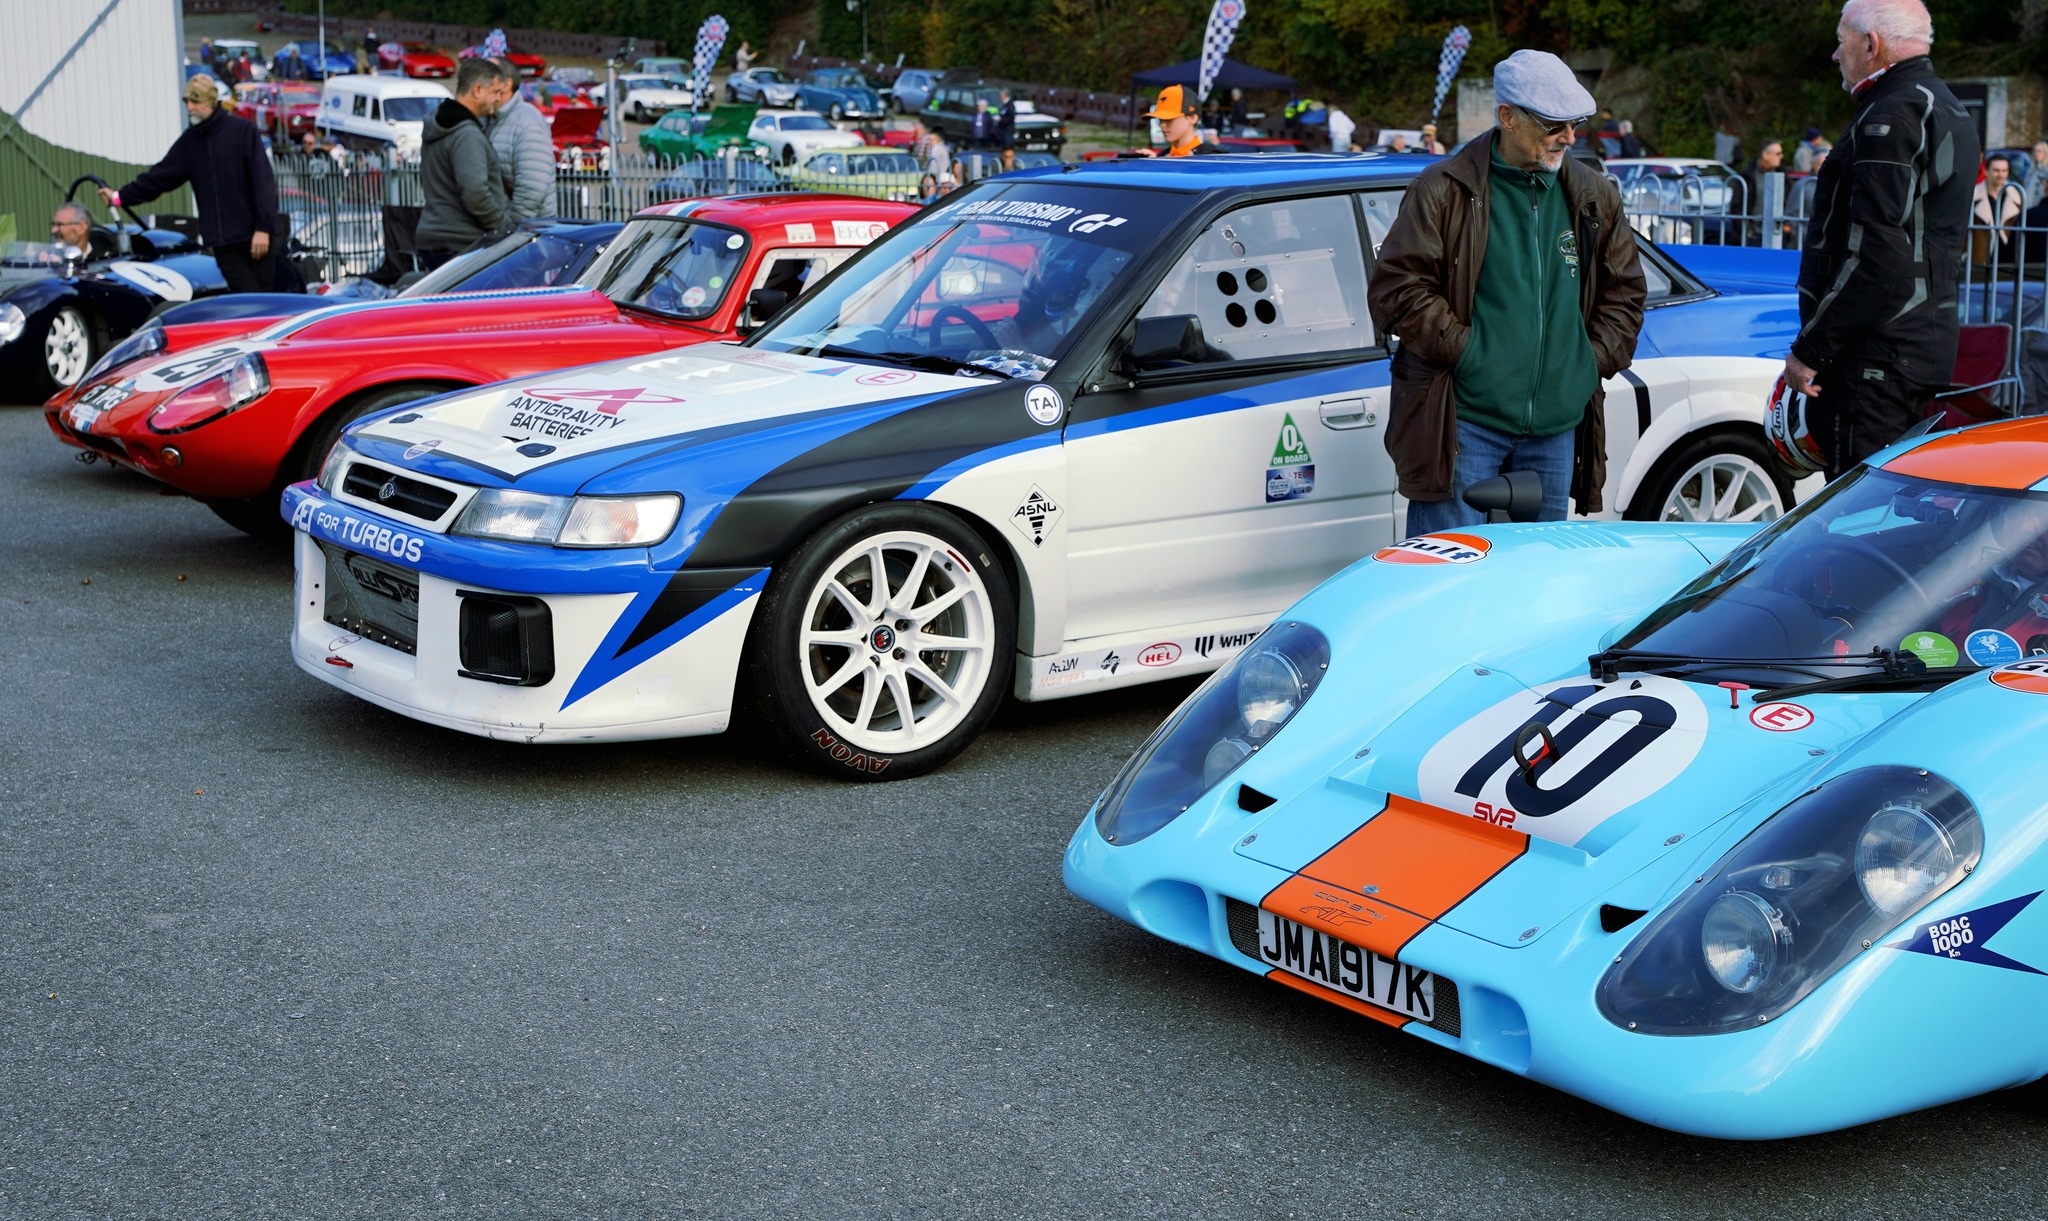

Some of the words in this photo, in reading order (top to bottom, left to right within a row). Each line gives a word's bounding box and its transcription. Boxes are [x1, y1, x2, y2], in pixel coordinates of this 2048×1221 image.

[956, 200, 1008, 215] GRAN
[837, 225, 868, 240] EFG
[1007, 216, 1052, 228] SIMULATOR
[867, 372, 906, 384] E
[507, 396, 627, 429] ANTIGRAVITY
[1030, 396, 1058, 411] TAI
[1273, 456, 1284, 465] ON
[1284, 454, 1309, 464] BOARD
[317, 512, 340, 532] FOR
[342, 515, 425, 563] TURBOS
[1389, 538, 1479, 561] Gulf
[1220, 631, 1260, 649] WHIT
[1145, 652, 1173, 663] HEL
[1761, 706, 1804, 728] E
[810, 727, 893, 774] AVON
[1454, 684, 1677, 817] 10
[1928, 916, 1971, 939] BOAC
[1931, 928, 1974, 954] 1000
[1262, 914, 1329, 984] JMA
[1339, 940, 1431, 1018] 917K
